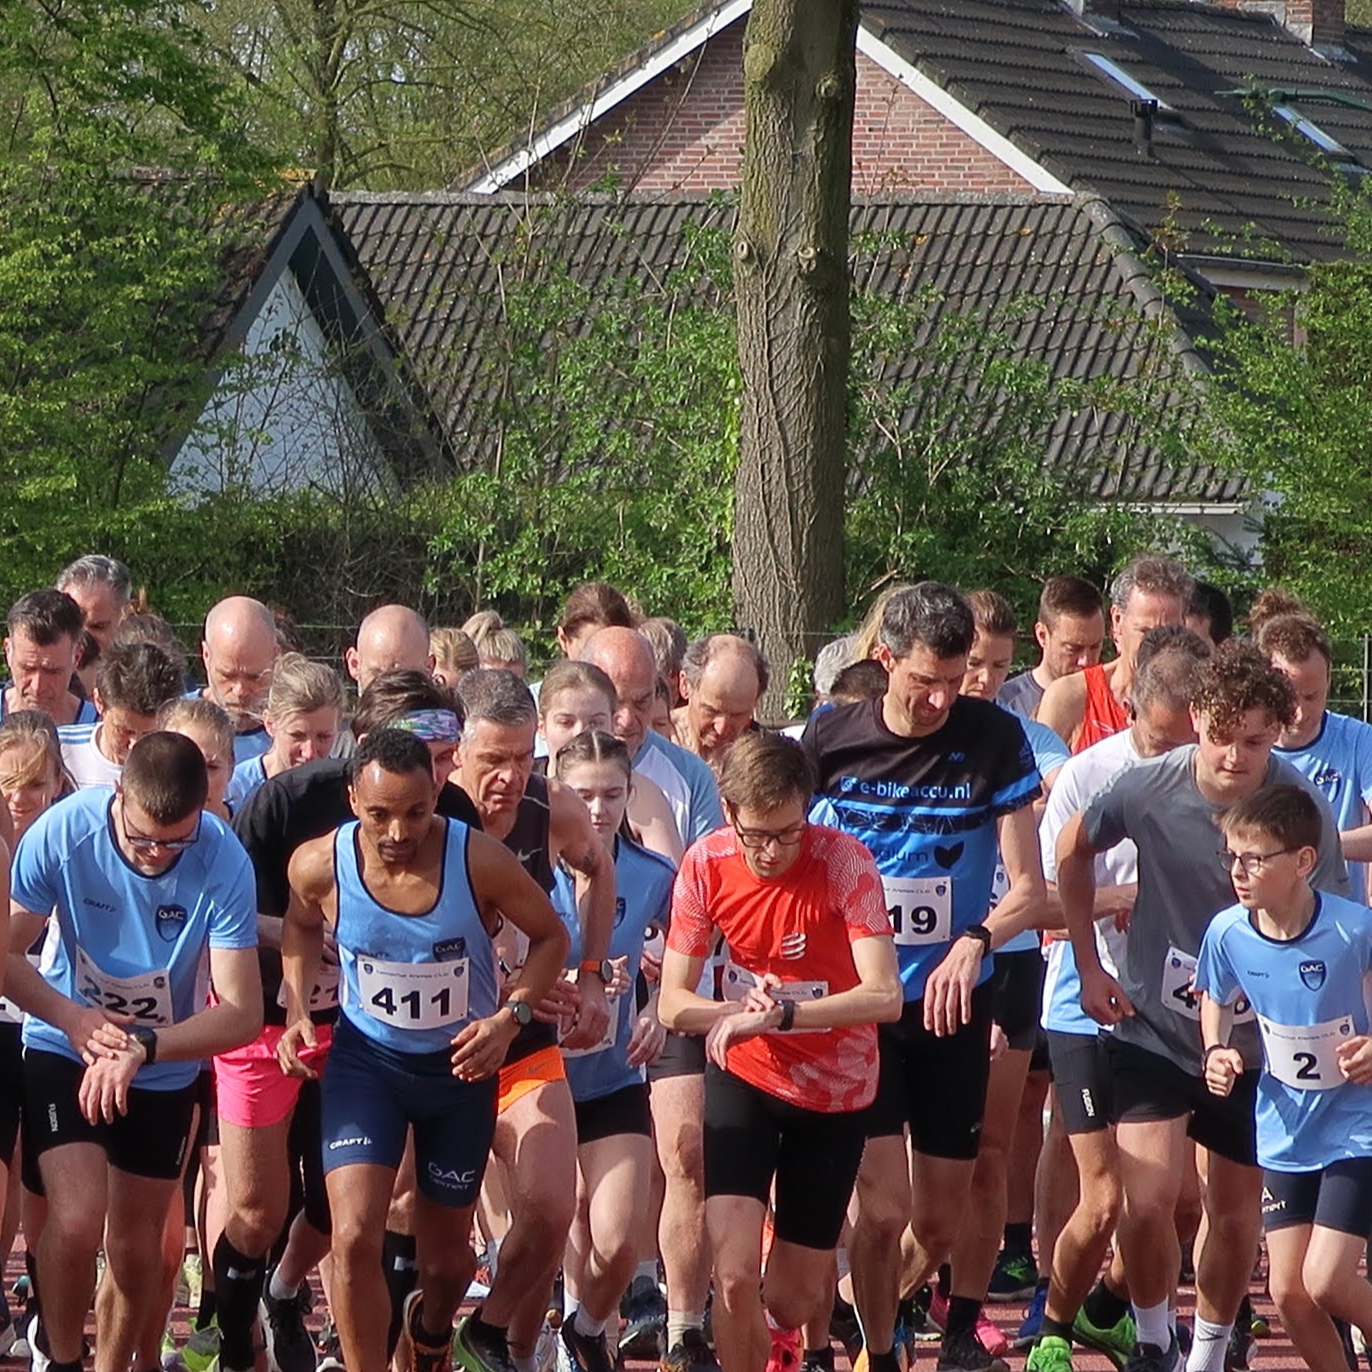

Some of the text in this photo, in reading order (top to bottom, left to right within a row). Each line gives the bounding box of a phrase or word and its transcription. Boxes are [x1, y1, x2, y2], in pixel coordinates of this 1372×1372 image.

[371, 987, 450, 1019] 411
[1292, 1051, 1321, 1080] 2
[329, 1137, 363, 1150] CRAFT
[427, 1161, 476, 1183] GAC
